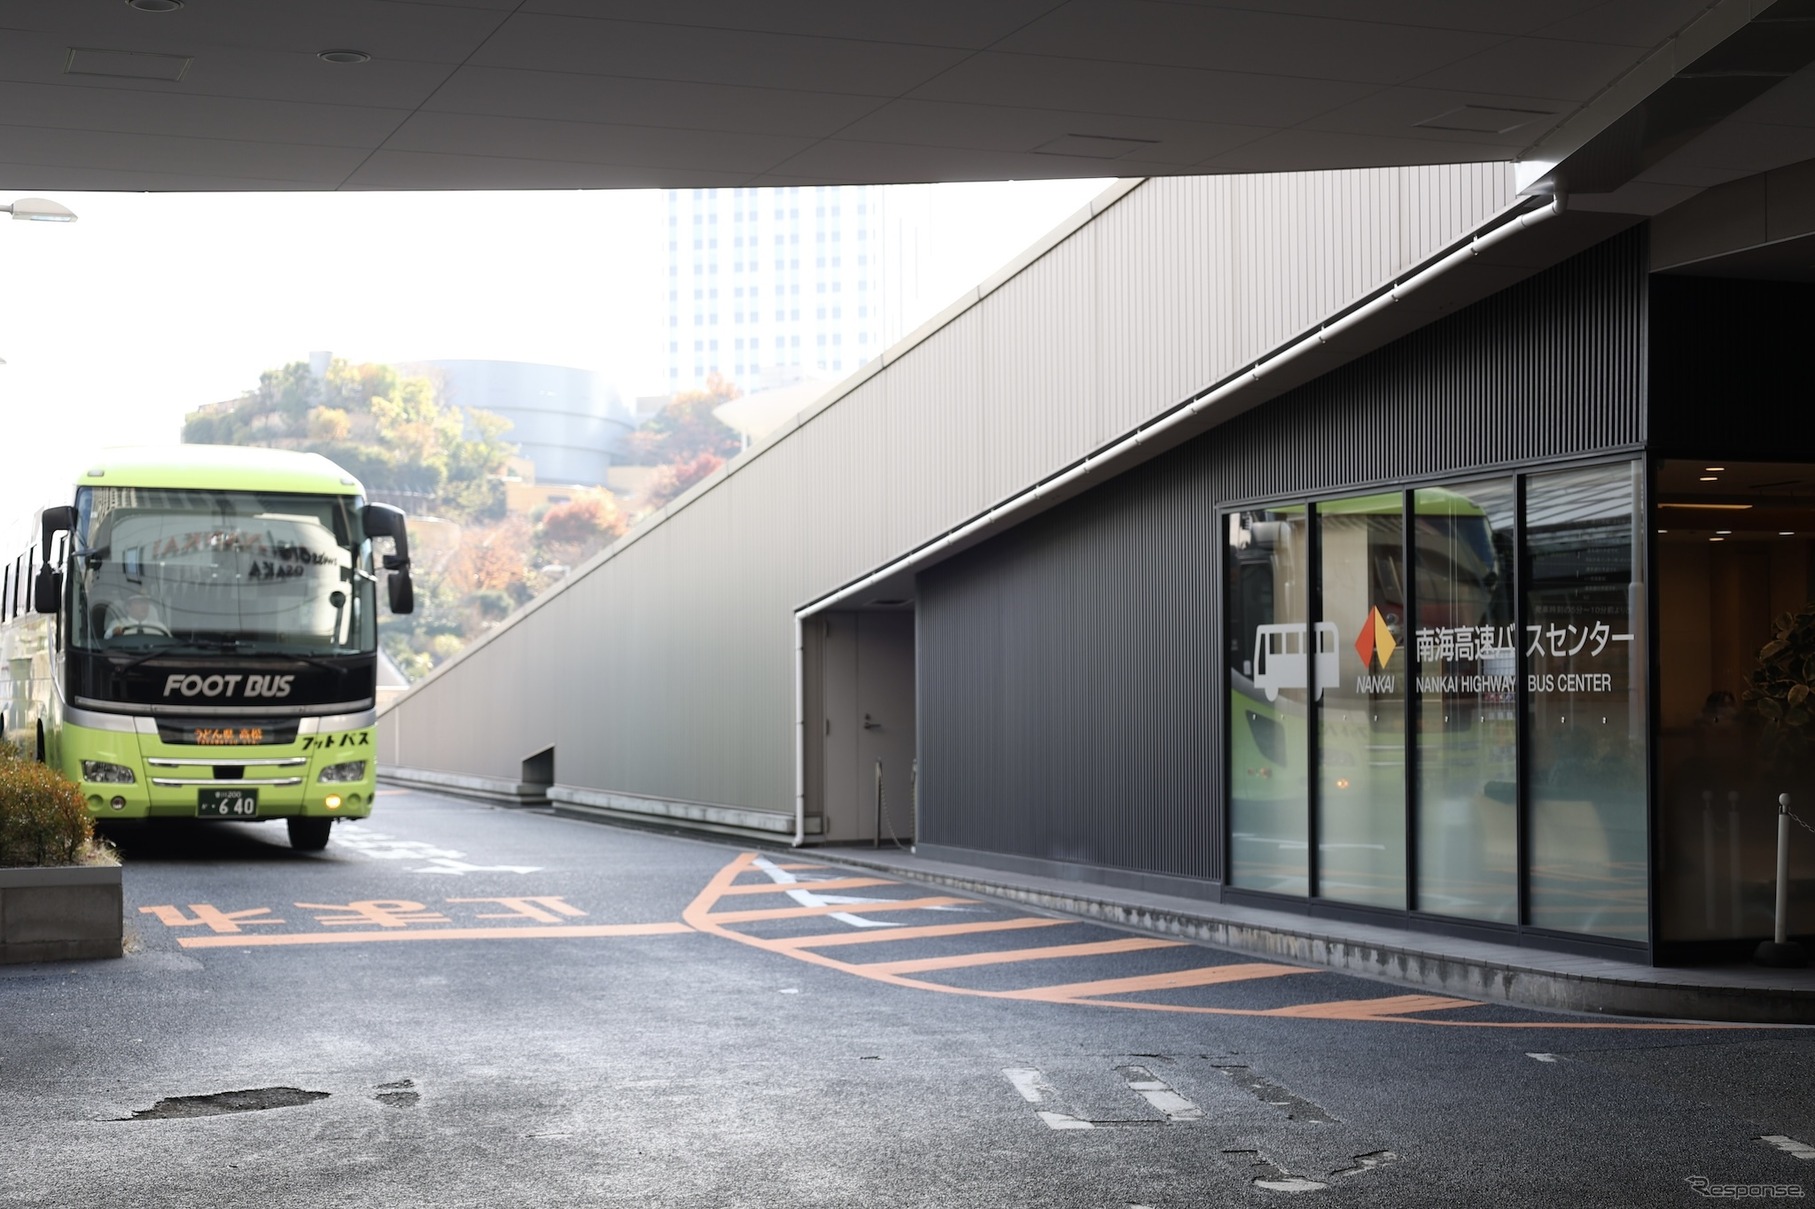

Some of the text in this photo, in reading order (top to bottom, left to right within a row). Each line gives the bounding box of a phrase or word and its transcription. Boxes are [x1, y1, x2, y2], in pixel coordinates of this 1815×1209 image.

[163, 674, 296, 697] FOOT BUS
[1356, 675, 1395, 694] NANKAI
[1416, 673, 1612, 693] NANKAI HIGHWAY BUS CENTER
